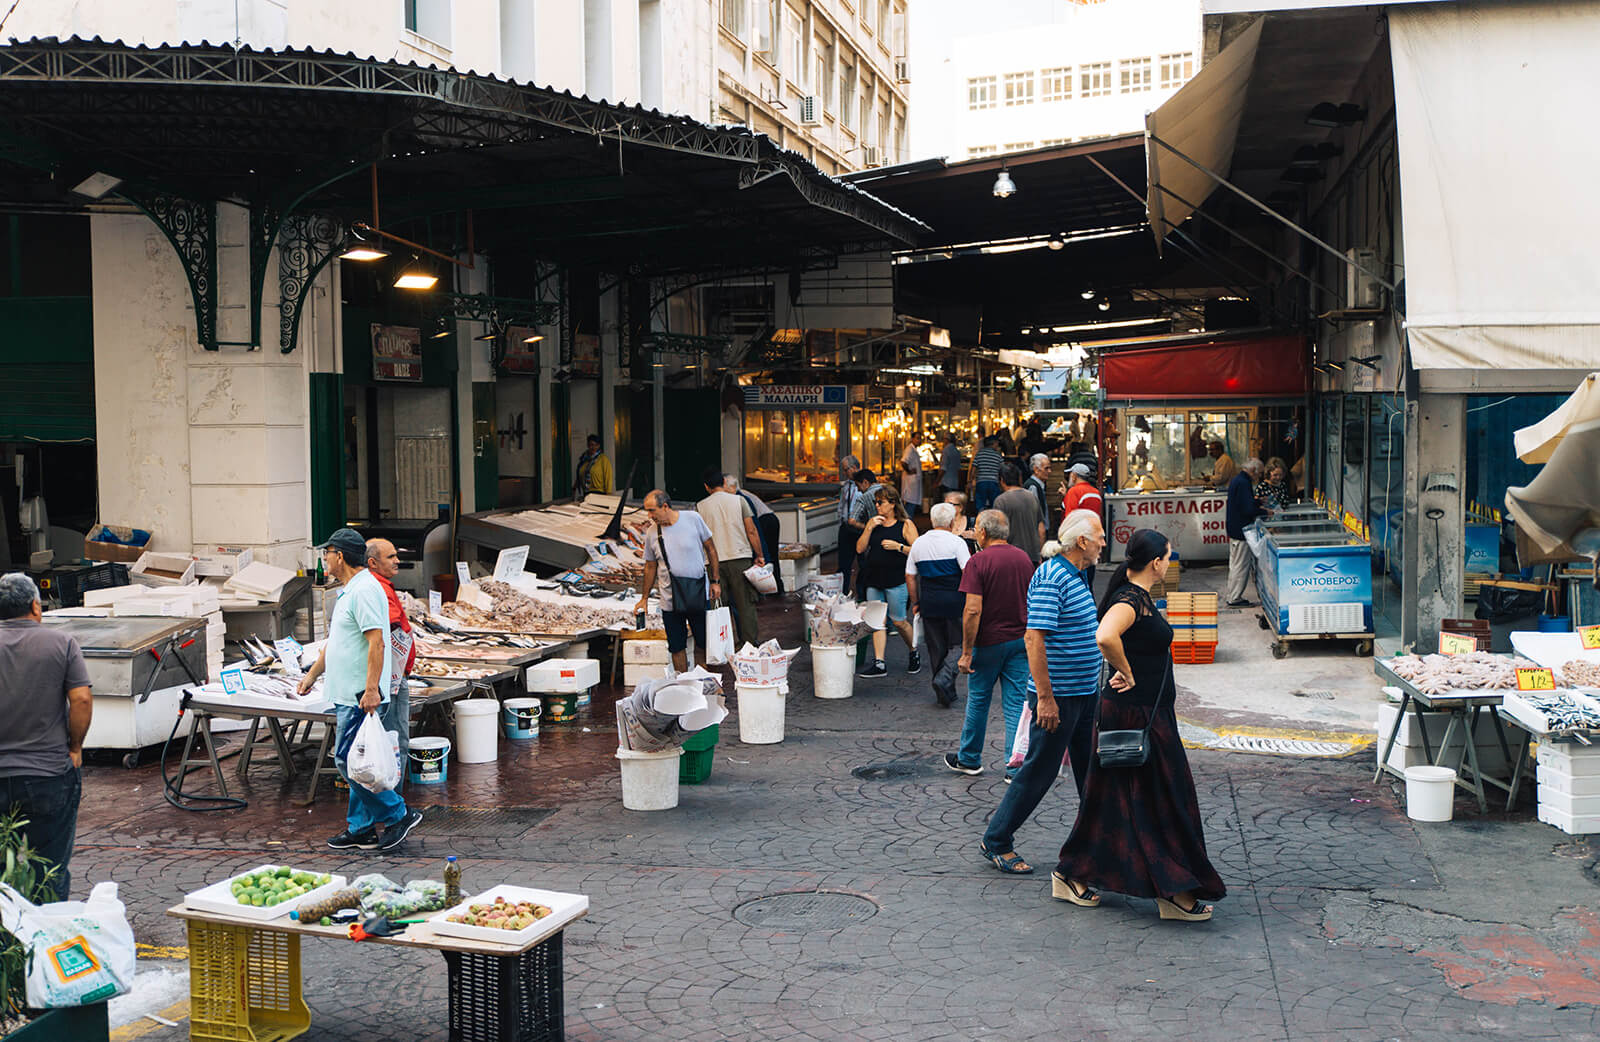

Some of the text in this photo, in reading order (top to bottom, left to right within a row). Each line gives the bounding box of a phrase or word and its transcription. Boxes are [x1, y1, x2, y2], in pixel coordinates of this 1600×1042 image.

[760, 385, 823, 395] ΧΑΣΑΠΙΚΟ
[764, 395, 818, 403] ΜΑΛΙΑΡΗ
[1291, 576, 1359, 586] ΚΟΝΤΟΒΕΡΟΣ
